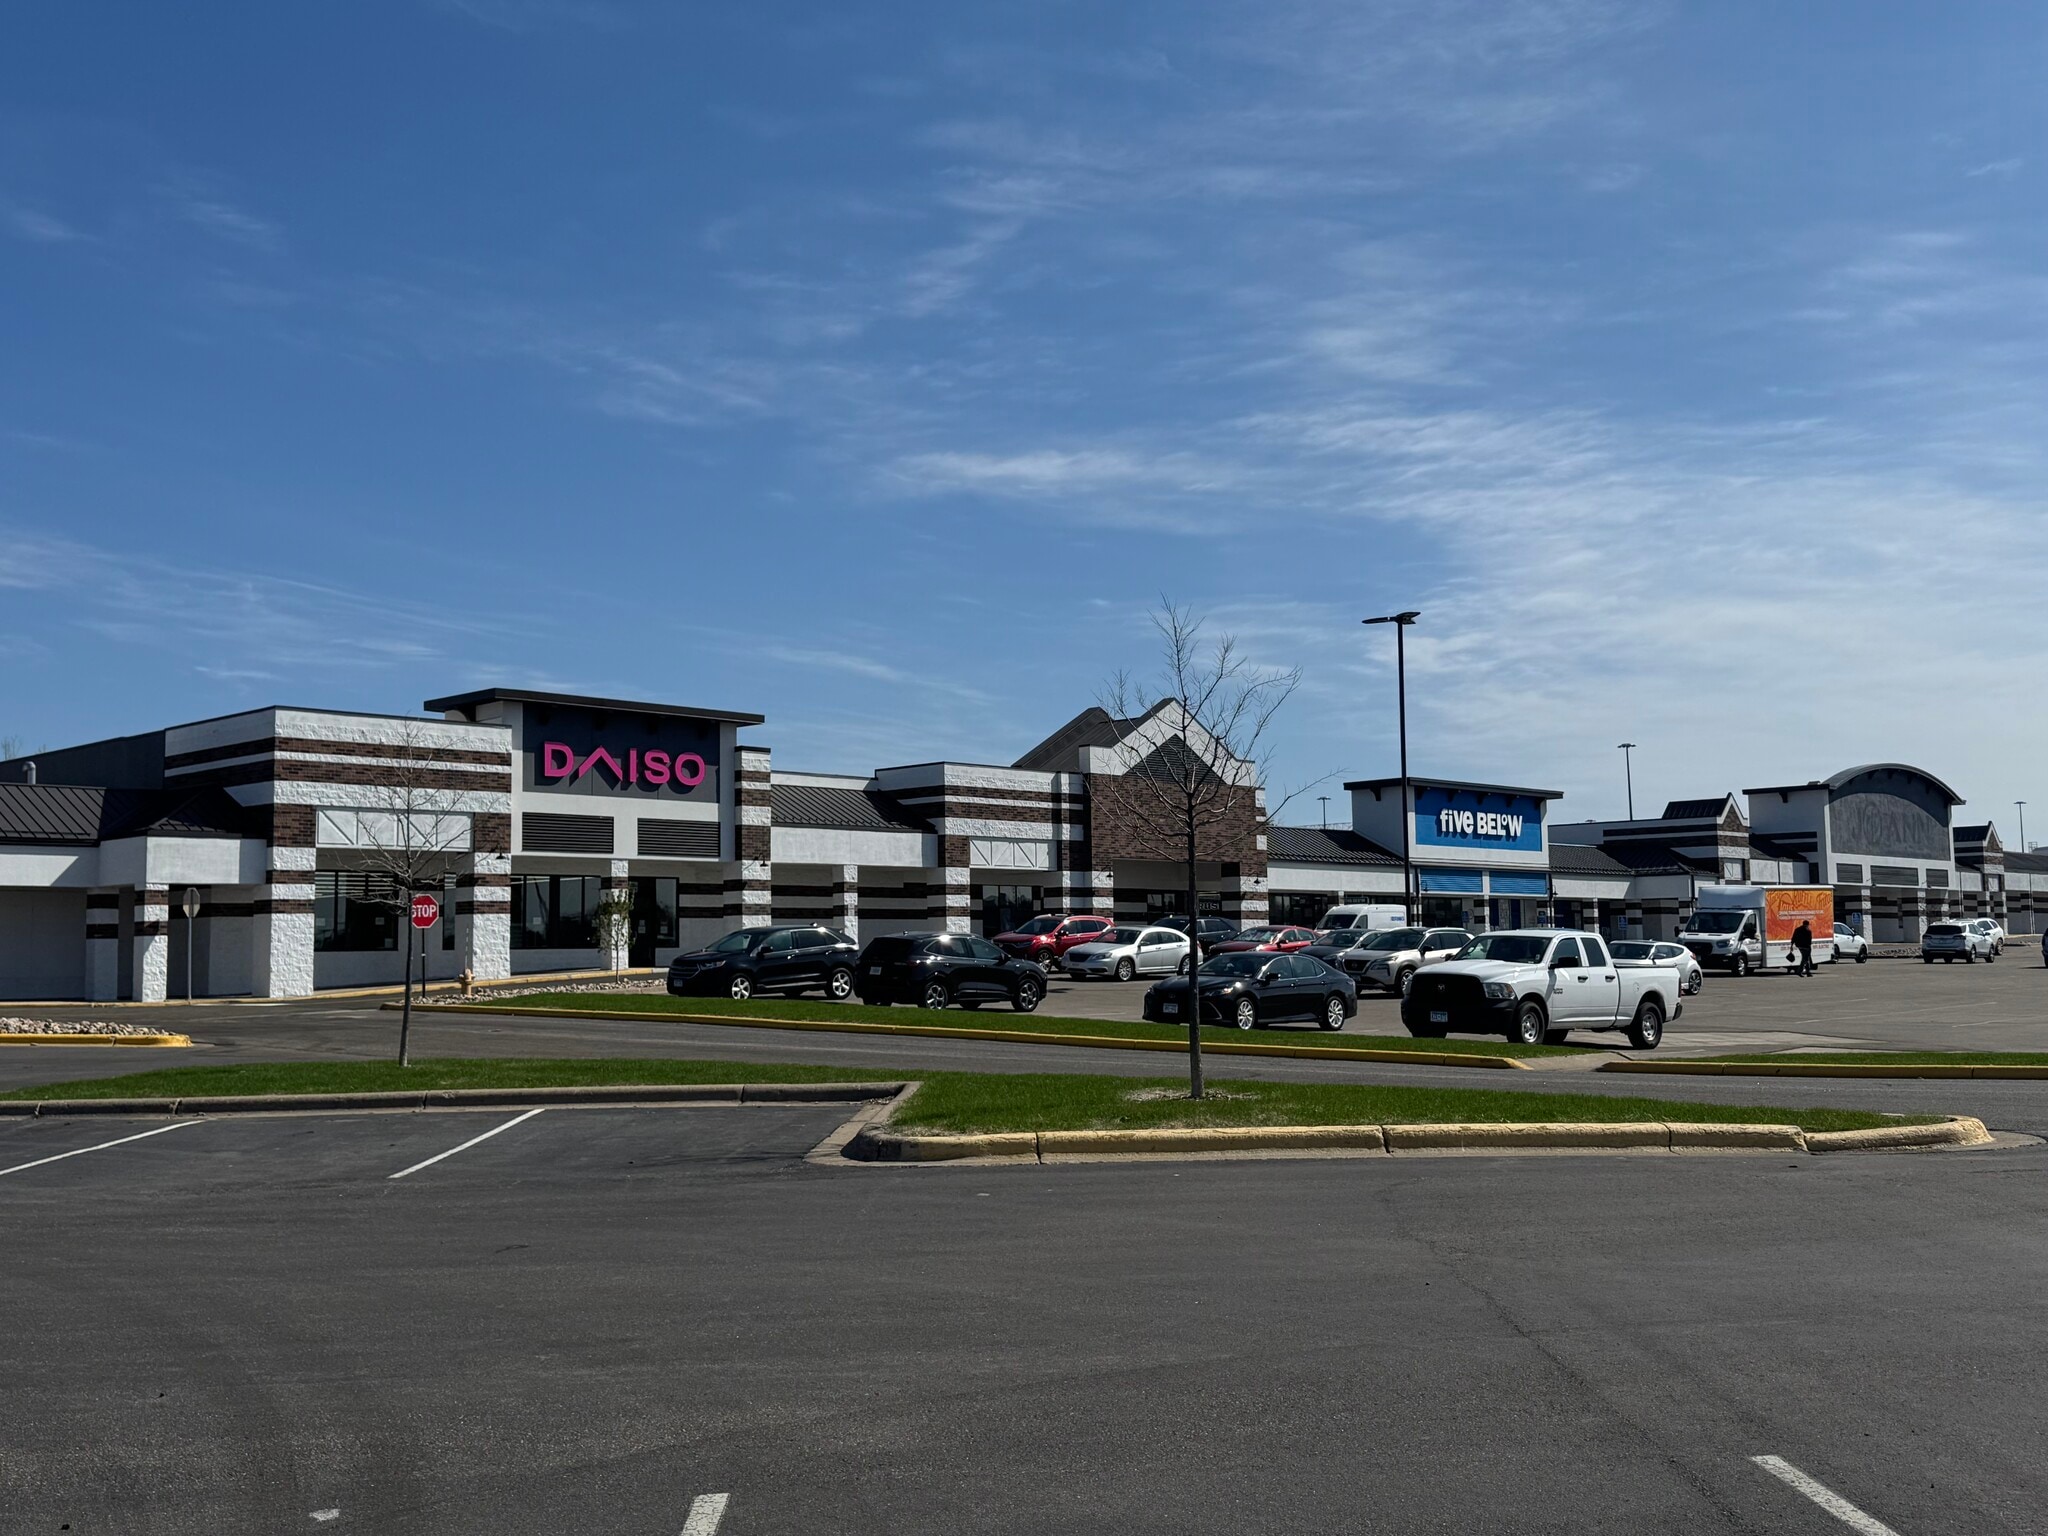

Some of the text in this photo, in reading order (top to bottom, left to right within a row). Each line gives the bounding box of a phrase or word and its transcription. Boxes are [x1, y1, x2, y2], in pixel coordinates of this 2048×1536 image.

[544, 741, 706, 786] DAISO
[1440, 808, 1474, 834] five
[411, 904, 437, 918] STOP
